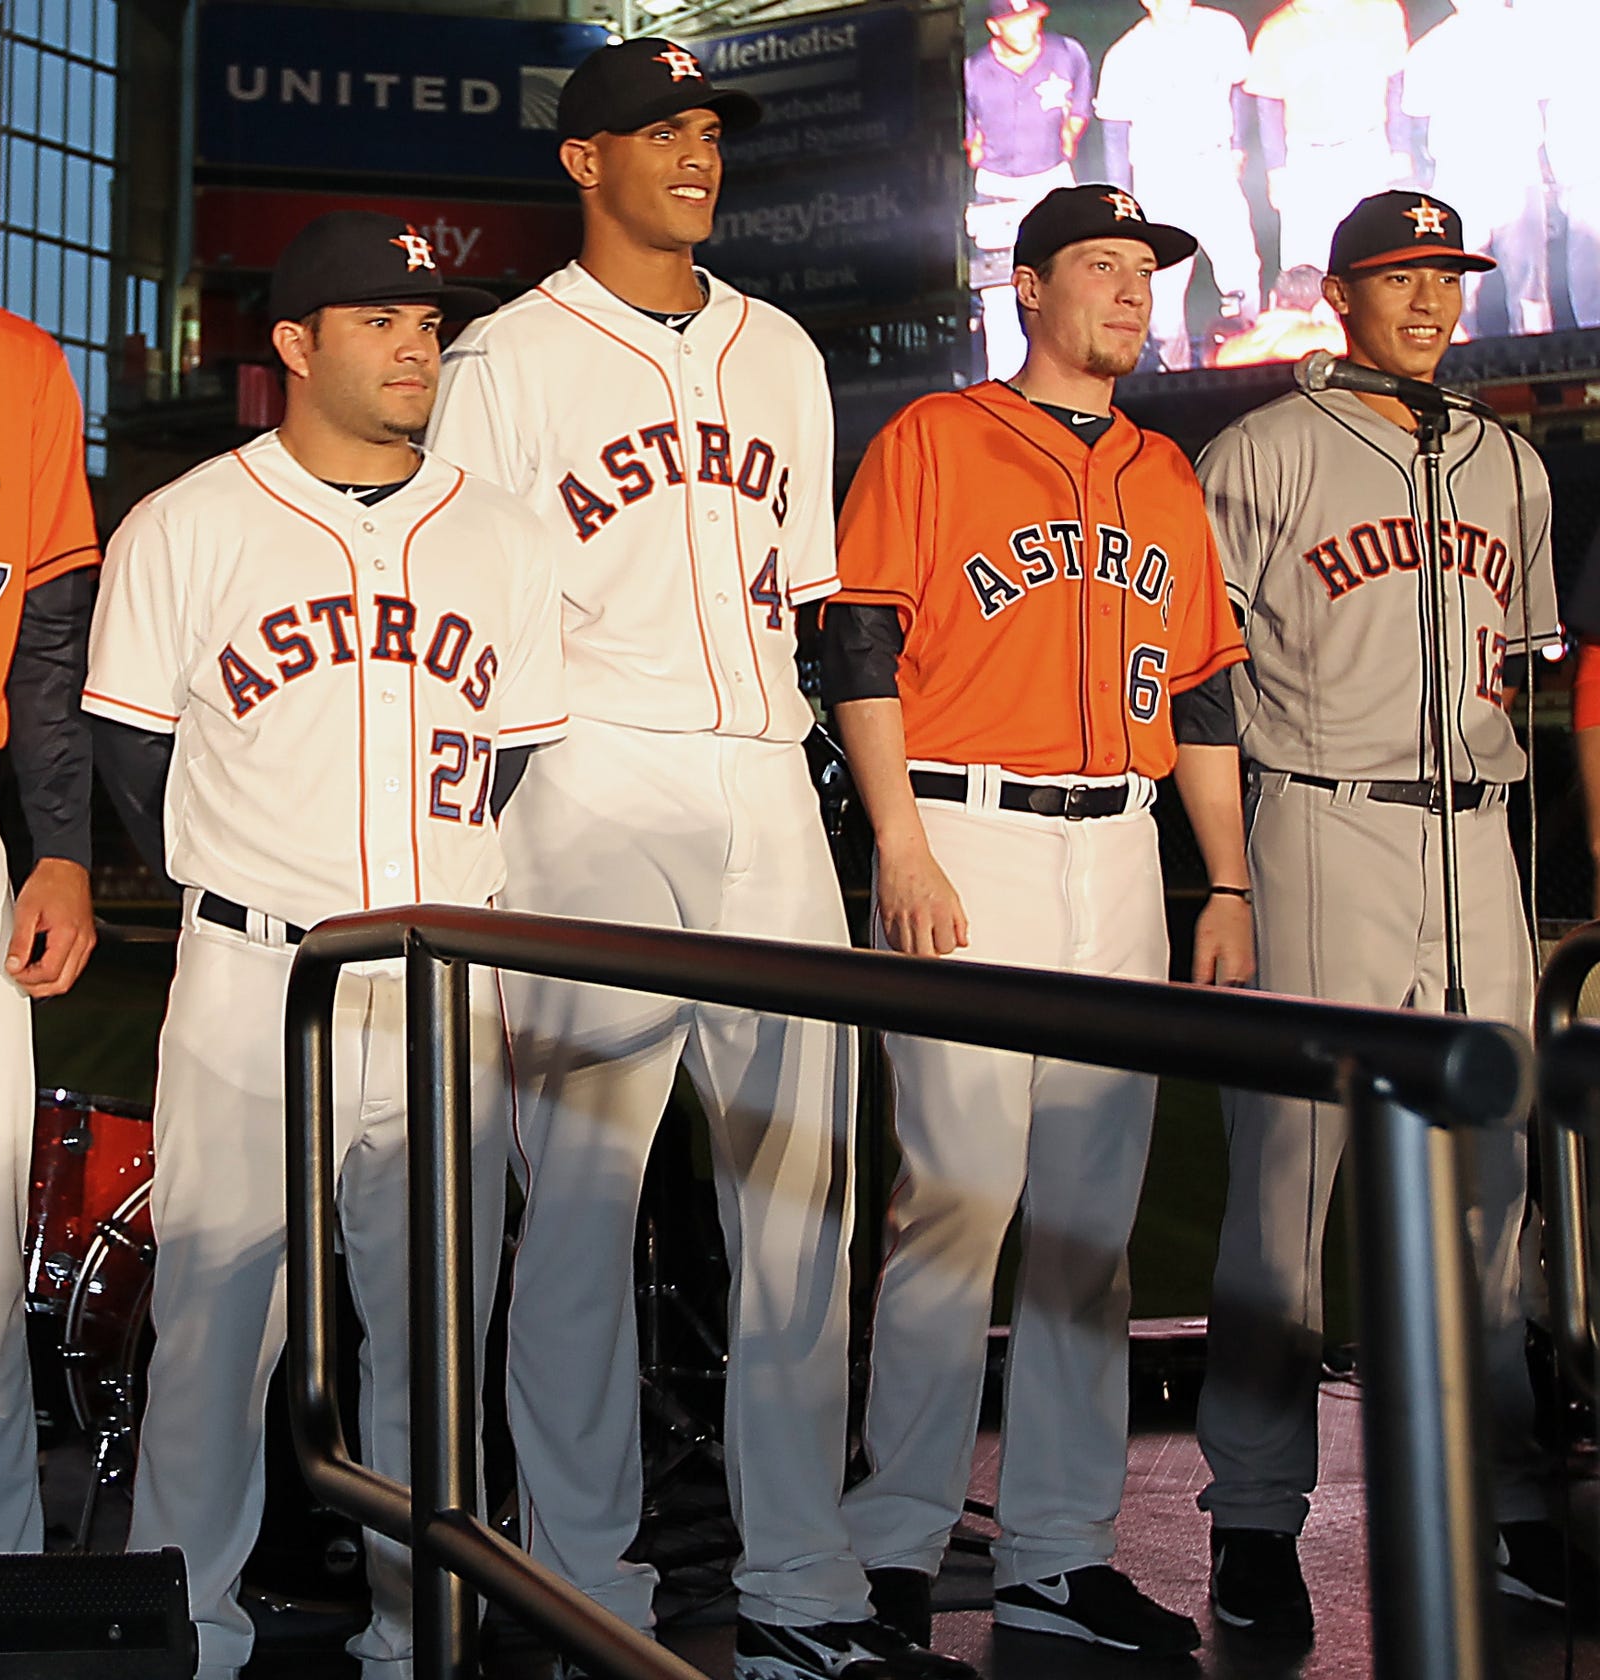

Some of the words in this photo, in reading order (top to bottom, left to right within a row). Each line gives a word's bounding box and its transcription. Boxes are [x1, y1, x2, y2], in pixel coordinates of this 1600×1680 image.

[660, 51, 702, 77] H
[708, 23, 858, 73] Methodist
[226, 65, 501, 114] UNITED
[1108, 193, 1142, 221] H
[1411, 207, 1445, 234] H
[398, 235, 436, 269] H
[963, 520, 1174, 631] ASTRO
[217, 594, 499, 719] ASTROS
[1127, 643, 1168, 724] 6
[428, 729, 493, 827] 27
